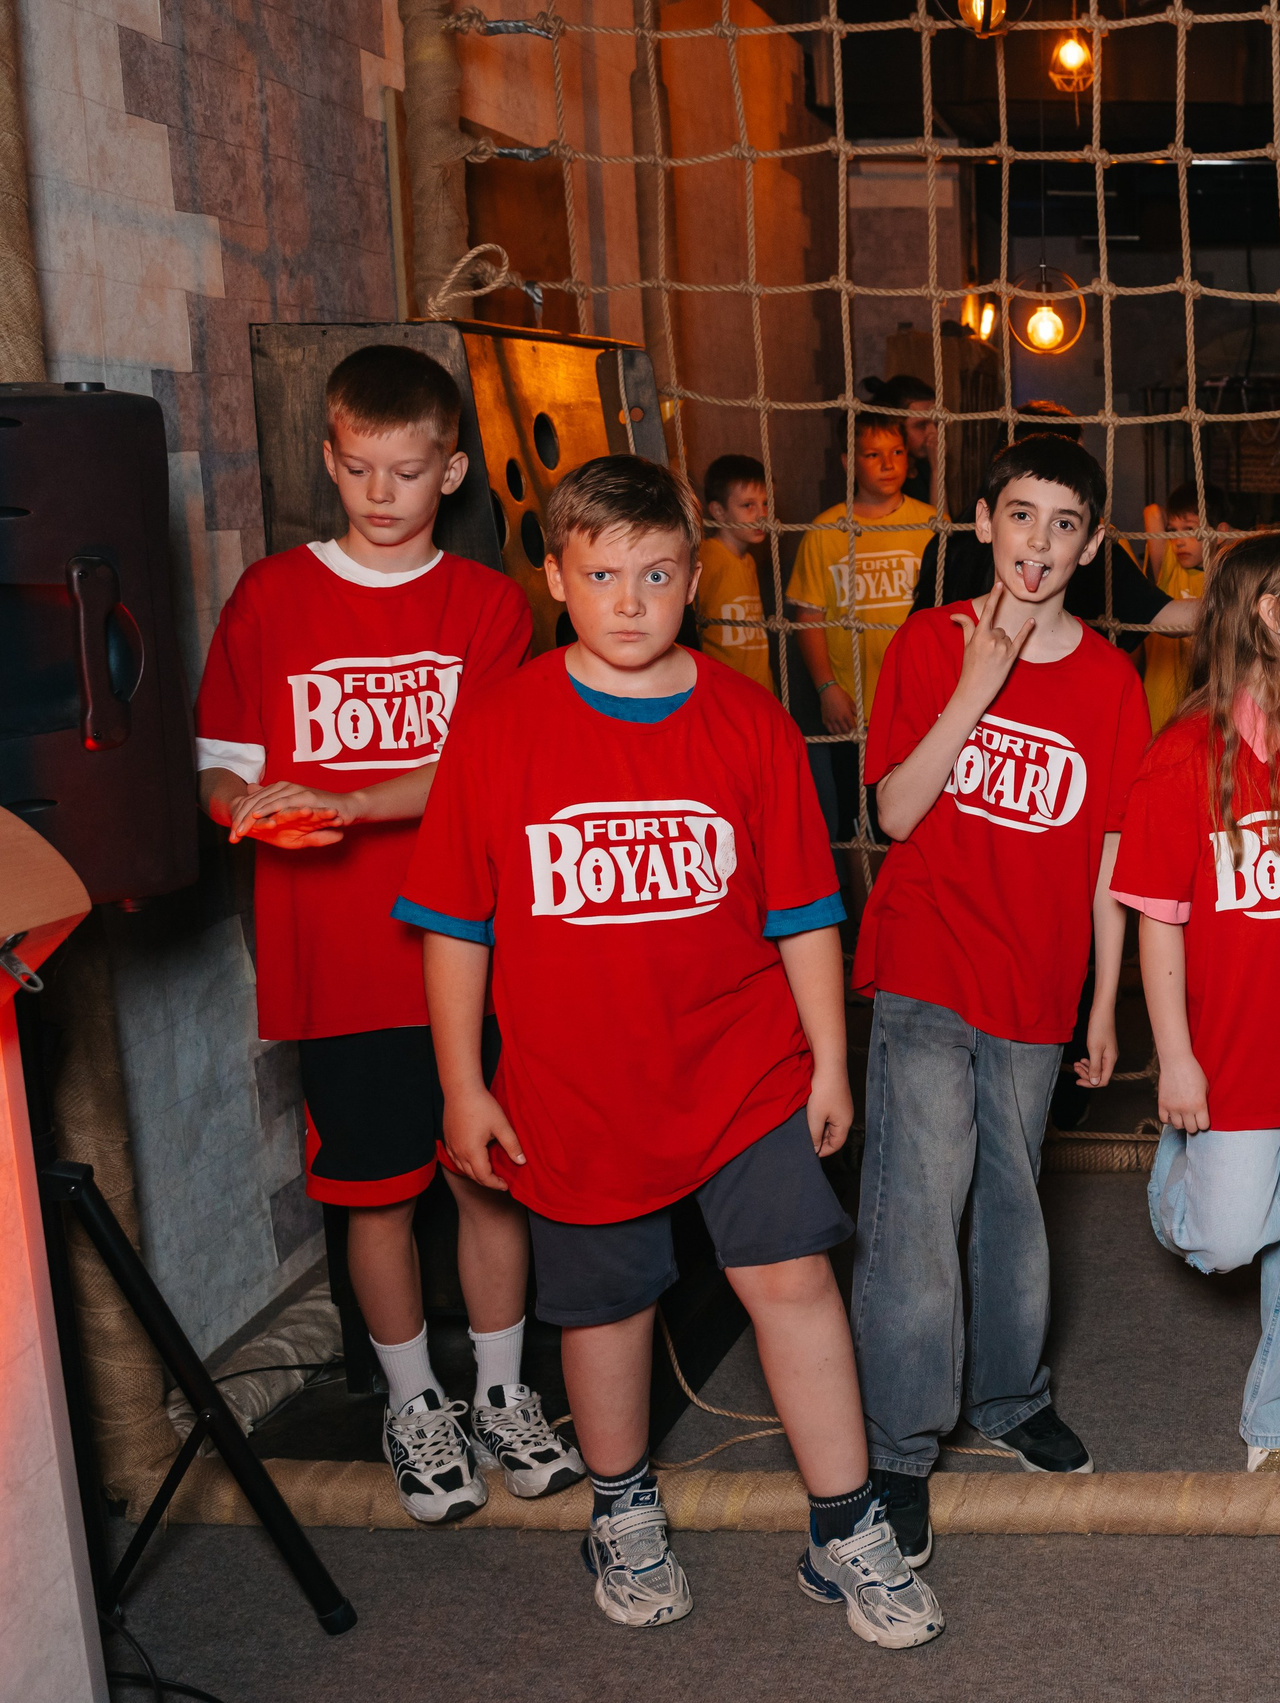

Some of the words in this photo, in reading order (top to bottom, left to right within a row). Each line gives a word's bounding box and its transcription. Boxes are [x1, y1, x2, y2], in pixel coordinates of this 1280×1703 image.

[343, 666, 434, 694] FORT
[968, 726, 1044, 760] FORT
[943, 745, 1087, 827] OYARD
[584, 817, 682, 842] FORT
[525, 816, 737, 916] BOYARD
